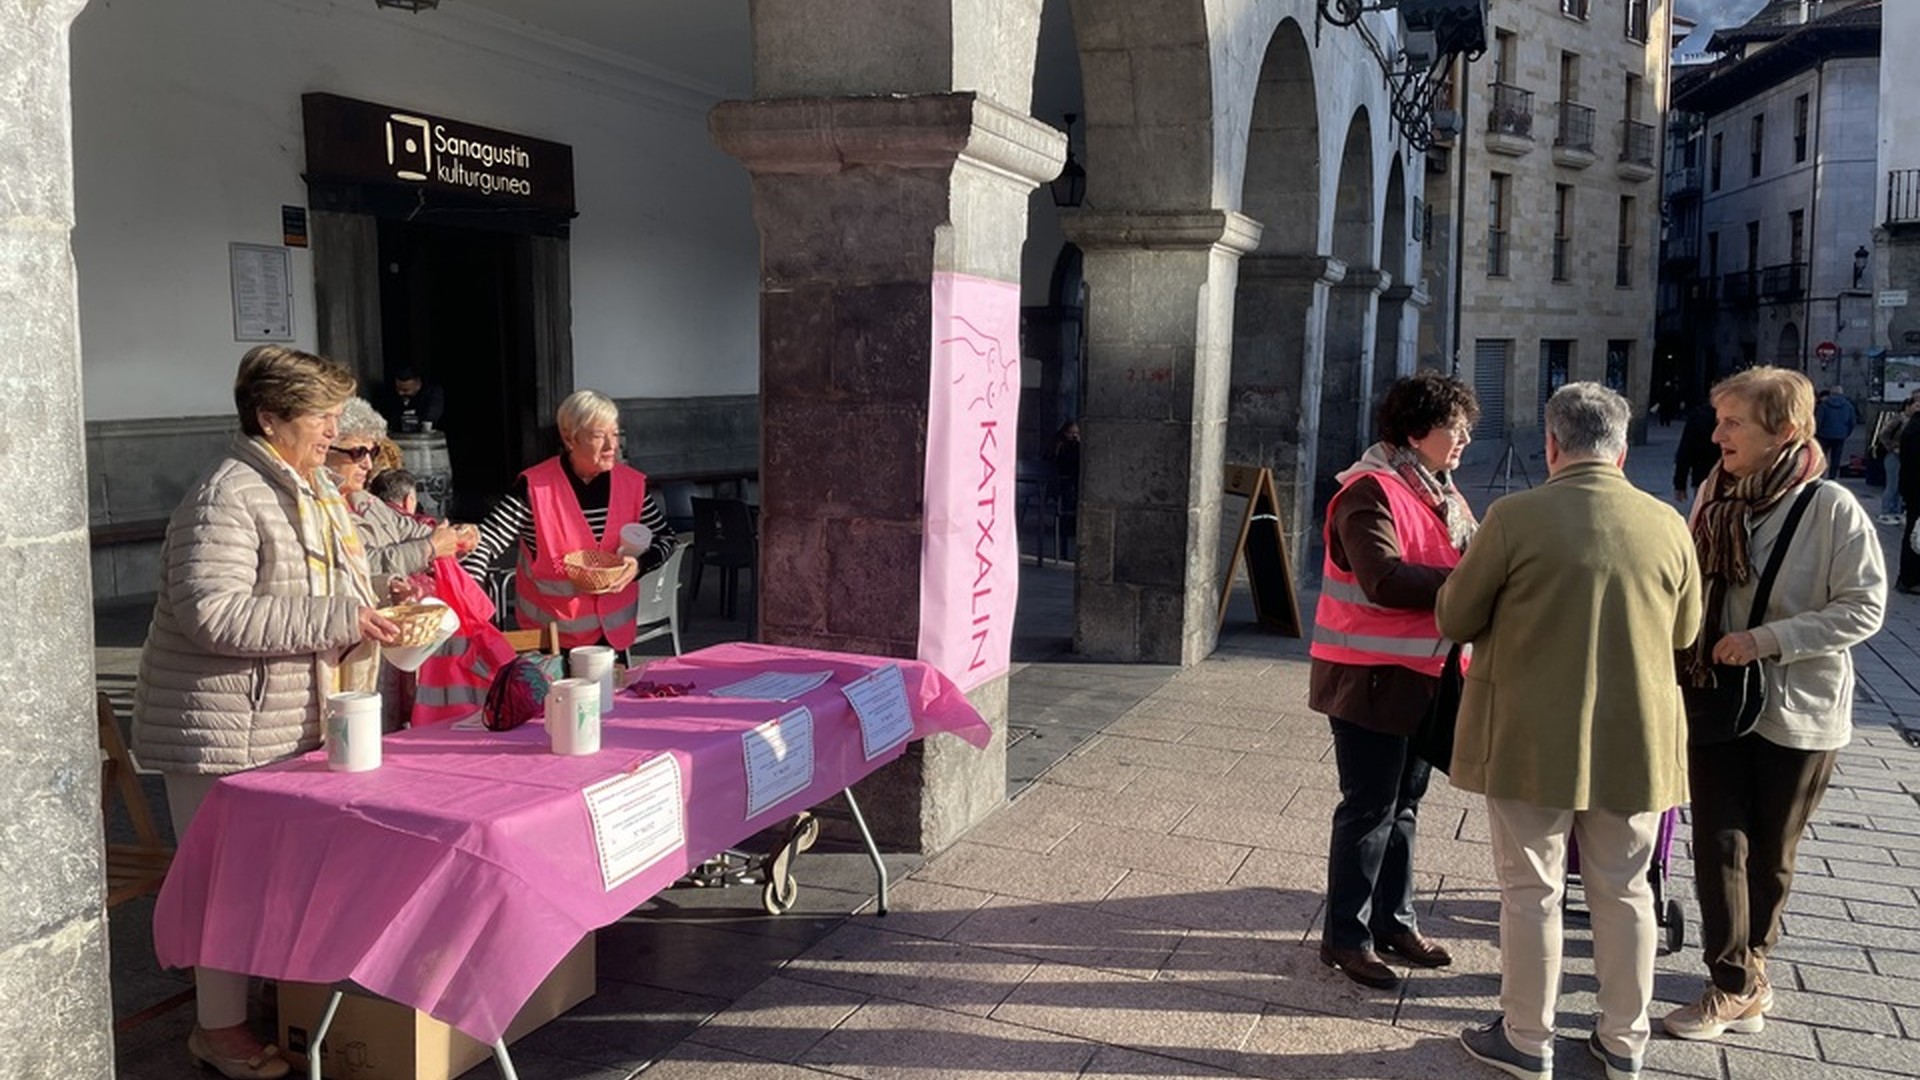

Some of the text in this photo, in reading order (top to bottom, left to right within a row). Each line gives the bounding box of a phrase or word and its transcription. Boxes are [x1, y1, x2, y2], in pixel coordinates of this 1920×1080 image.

[434, 125, 530, 168] Sanagustin
[437, 155, 531, 195] kulturgunea
[967, 421, 997, 672] KATXALIN
